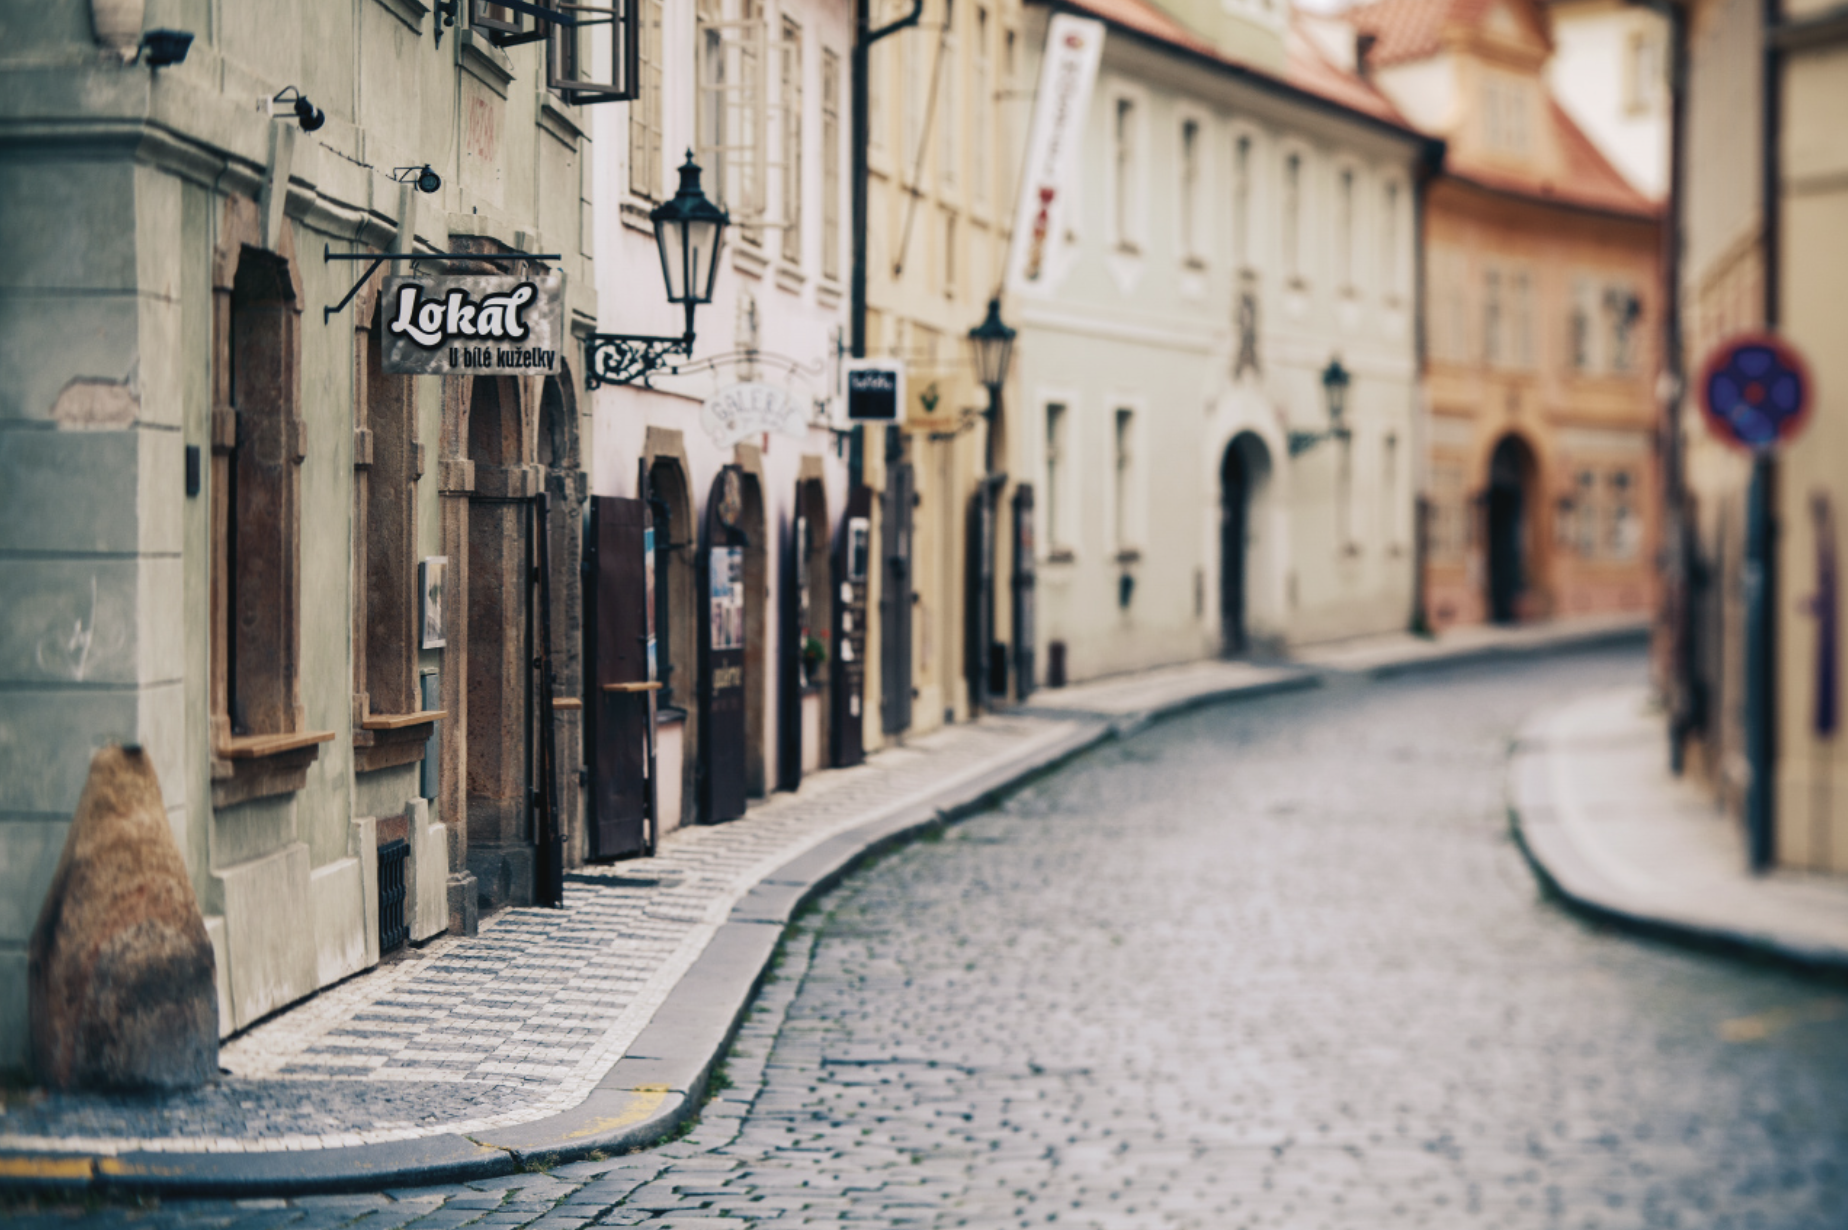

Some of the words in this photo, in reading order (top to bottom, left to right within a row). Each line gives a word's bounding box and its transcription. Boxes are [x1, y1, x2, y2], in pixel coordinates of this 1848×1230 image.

[449, 348, 459, 368] U
[463, 346, 492, 368] bílé
[496, 346, 556, 371] kuželky
